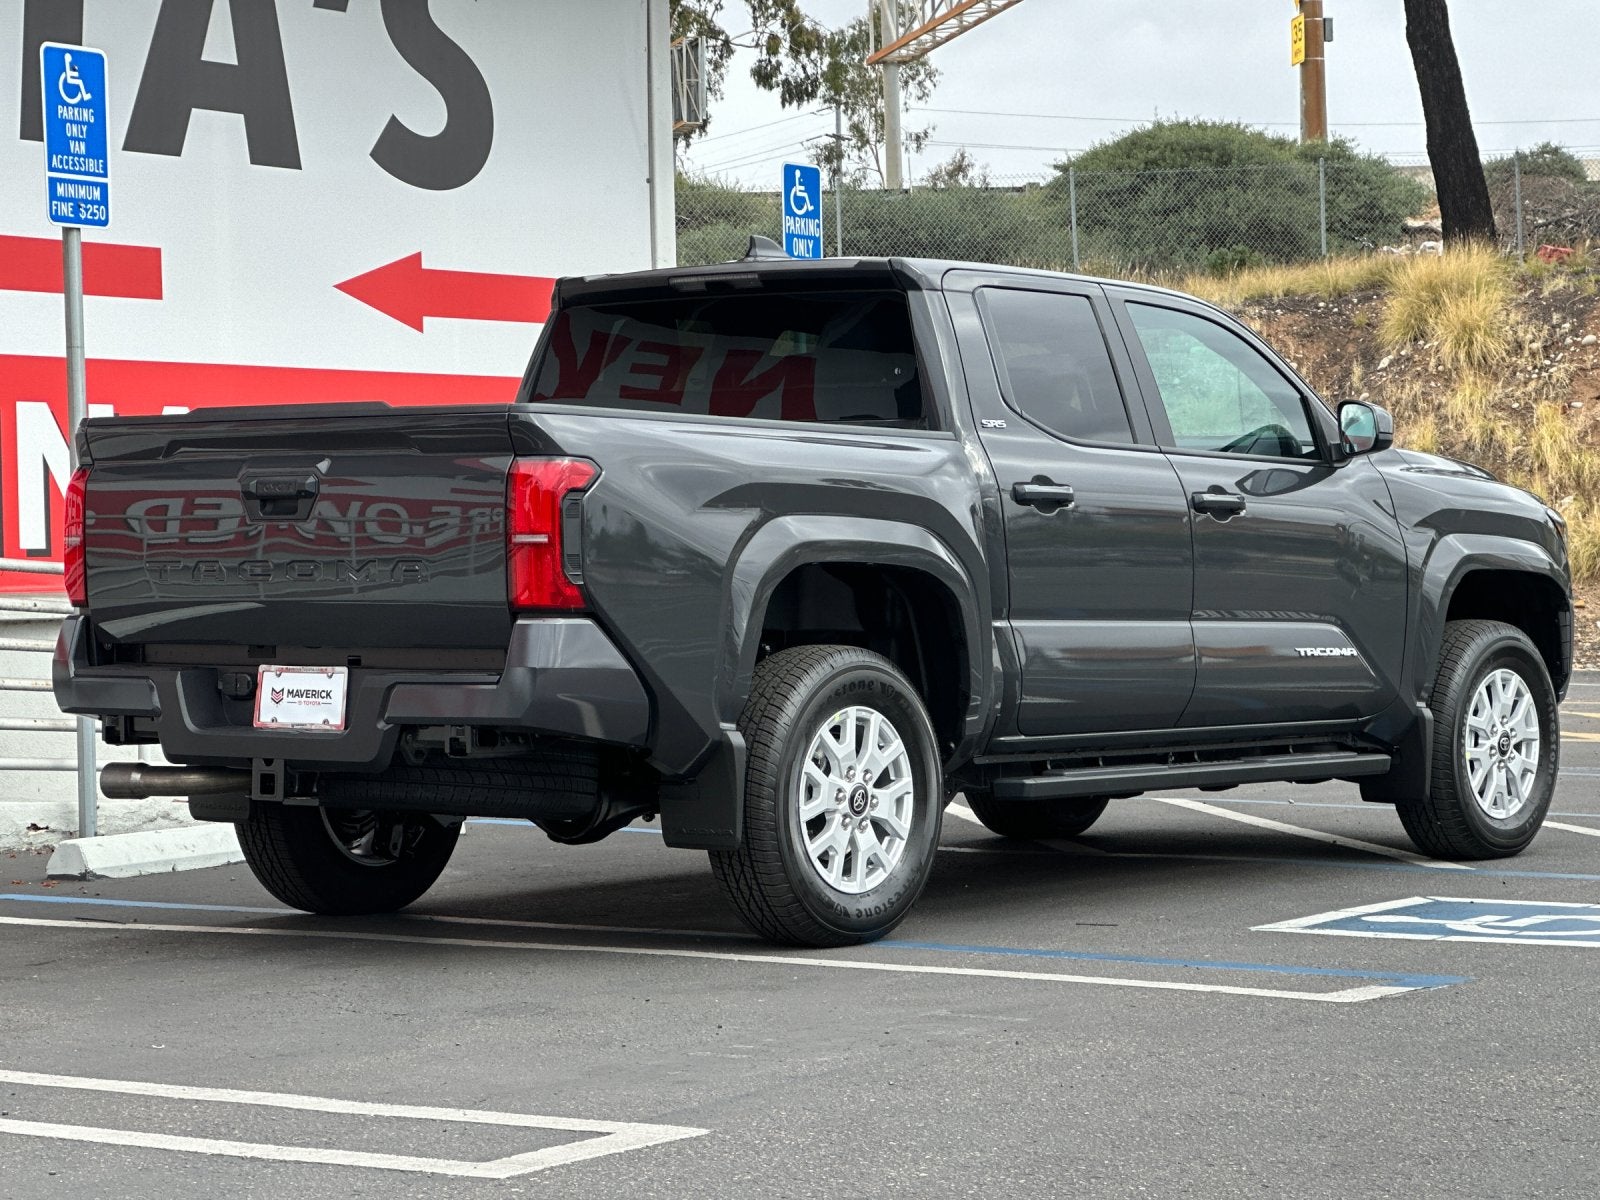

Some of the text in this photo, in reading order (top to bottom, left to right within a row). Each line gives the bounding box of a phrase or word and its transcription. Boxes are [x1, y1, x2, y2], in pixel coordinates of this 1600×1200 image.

[1293, 21, 1303, 44] 35
[58, 105, 95, 123] PARKING
[65, 124, 87, 139] ONLY
[69, 140, 86, 155] VAN
[51, 154, 104, 174] ACCESSIBLE
[56, 182, 101, 201] MINIMUM
[52, 201, 106, 221] FINE $250
[785, 215, 820, 237] PARKING
[792, 237, 814, 258] ONLY
[981, 418, 1007, 429] SR5
[145, 559, 430, 584] TACOMA
[1294, 647, 1359, 657] TACOMA
[286, 688, 333, 700] MAVERICK
